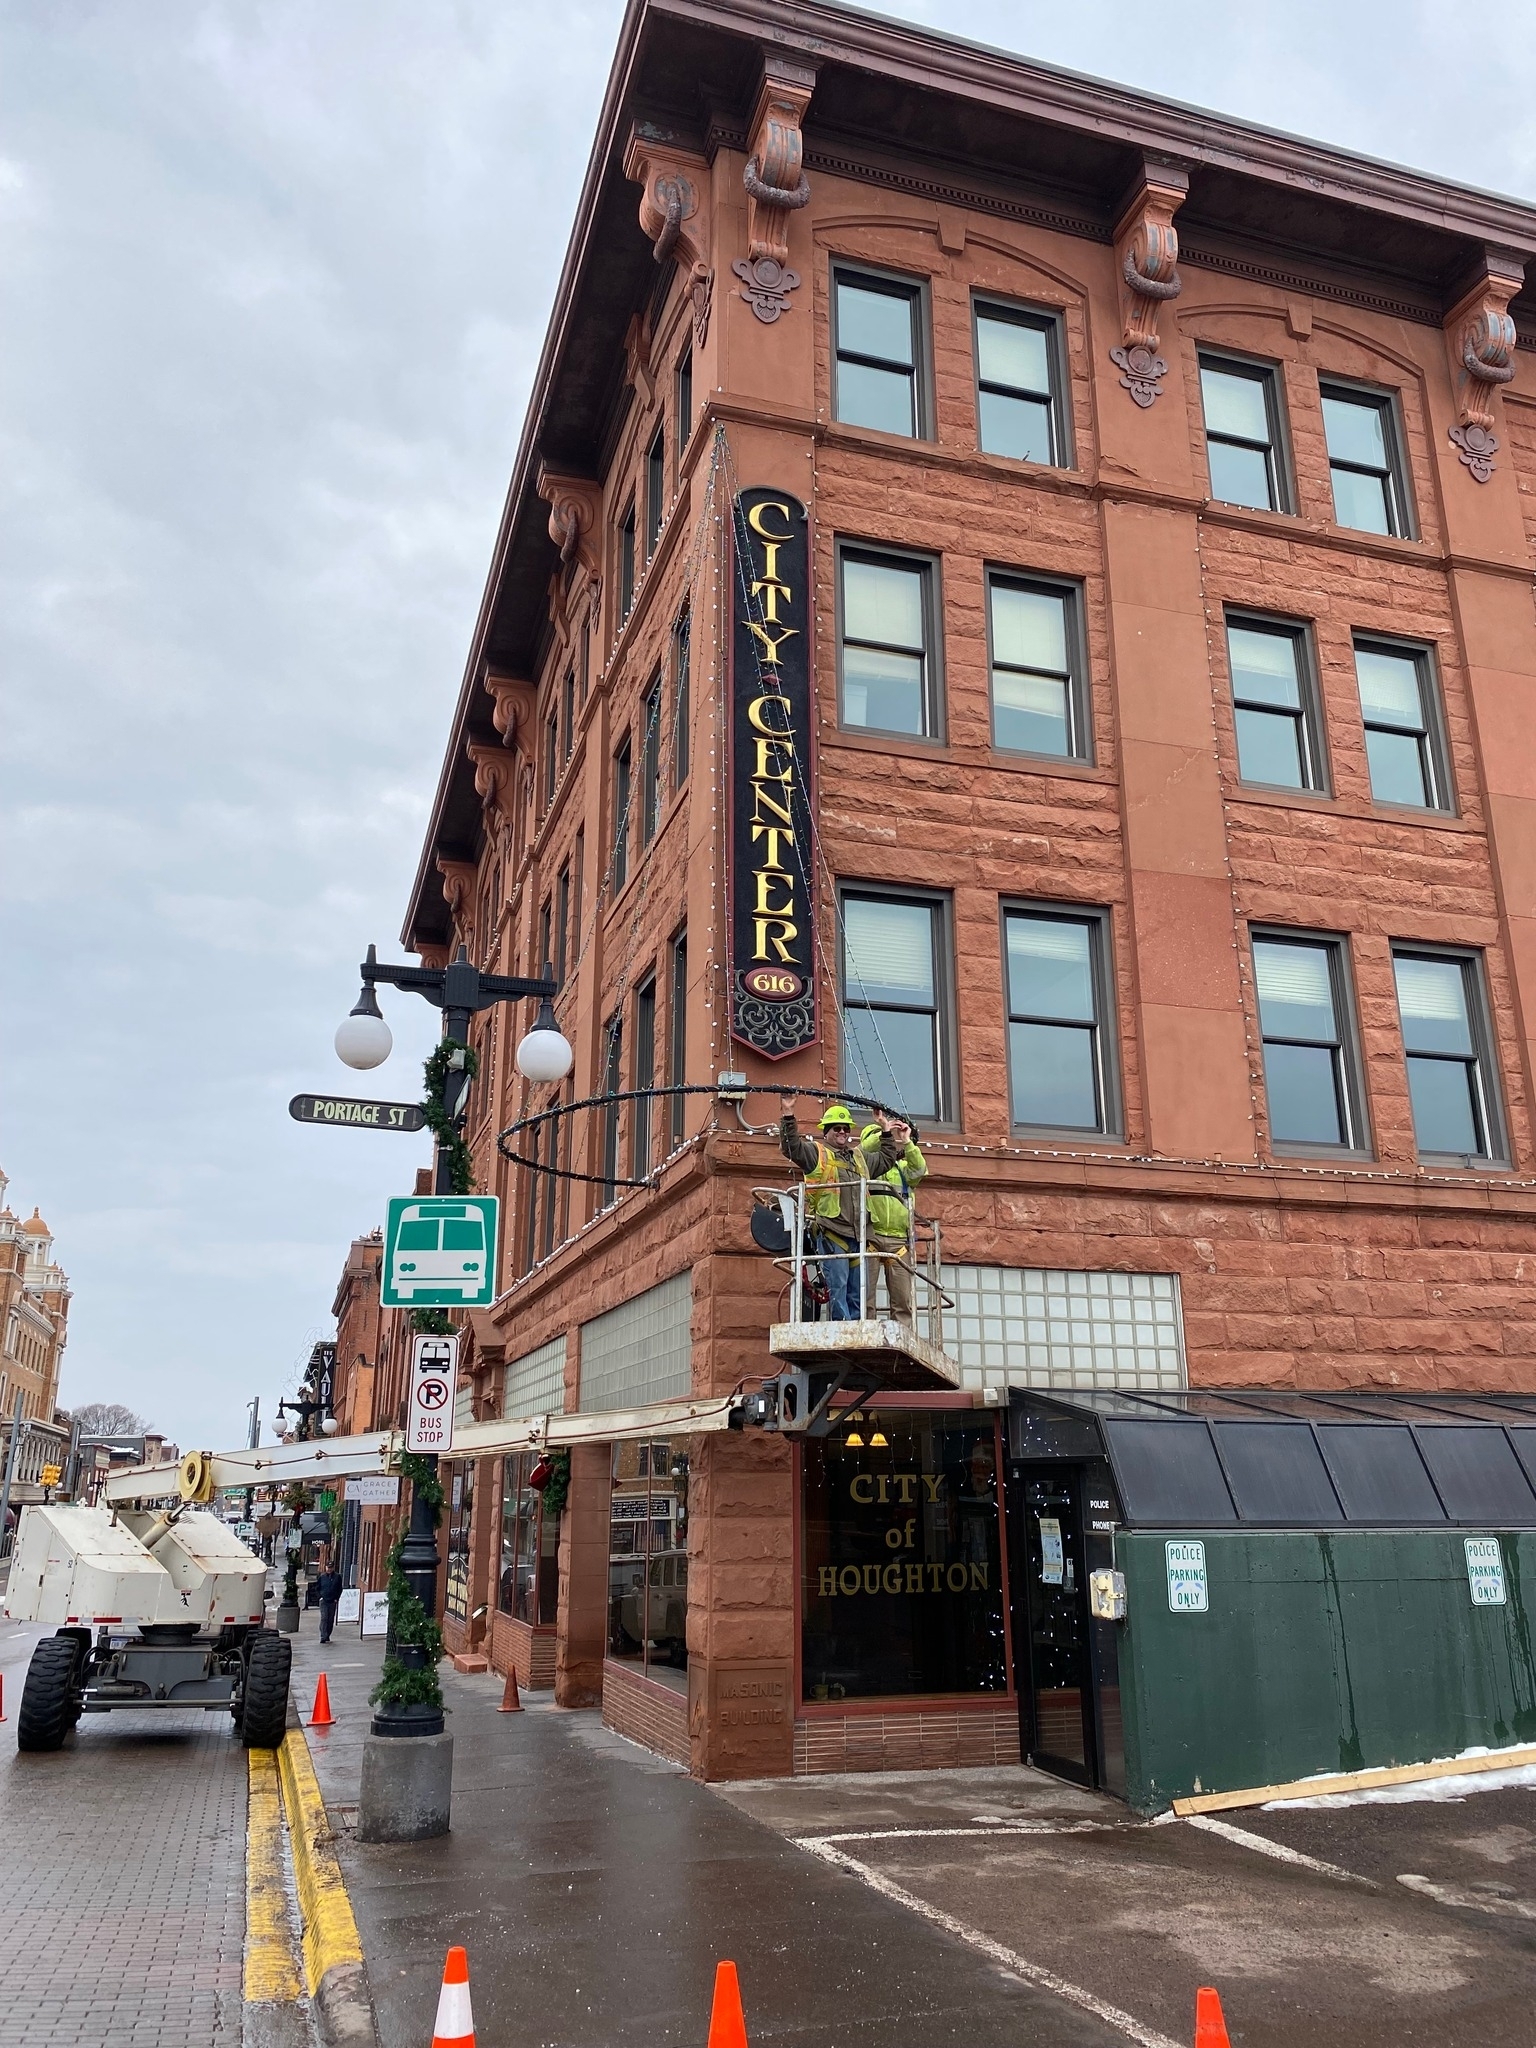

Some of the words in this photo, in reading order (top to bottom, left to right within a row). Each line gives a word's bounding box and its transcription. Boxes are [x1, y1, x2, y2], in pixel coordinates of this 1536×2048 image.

[741, 501, 800, 667] CITY
[747, 696, 802, 964] CENTER
[753, 974, 796, 994] 616
[313, 1100, 380, 1124] PORTAGE
[387, 1107, 408, 1126] ST
[420, 1417, 442, 1429] BUS
[417, 1431, 443, 1443] STOP
[850, 1474, 946, 1504] CITY
[1090, 1500, 1110, 1509] POLICE
[1092, 1521, 1110, 1530] PHONE
[885, 1518, 916, 1548] of
[1170, 1548, 1201, 1560] POLICE
[1468, 1545, 1497, 1557] POLICE
[1170, 1569, 1204, 1581] PARKING
[1470, 1565, 1501, 1578] PARKING
[818, 1562, 990, 1596] HOUGHTON
[1177, 1593, 1200, 1605] ONLY
[1477, 1586, 1498, 1599] ONLY
[720, 1681, 782, 1699] MASONIC
[720, 1708, 784, 1727] BUILDING
